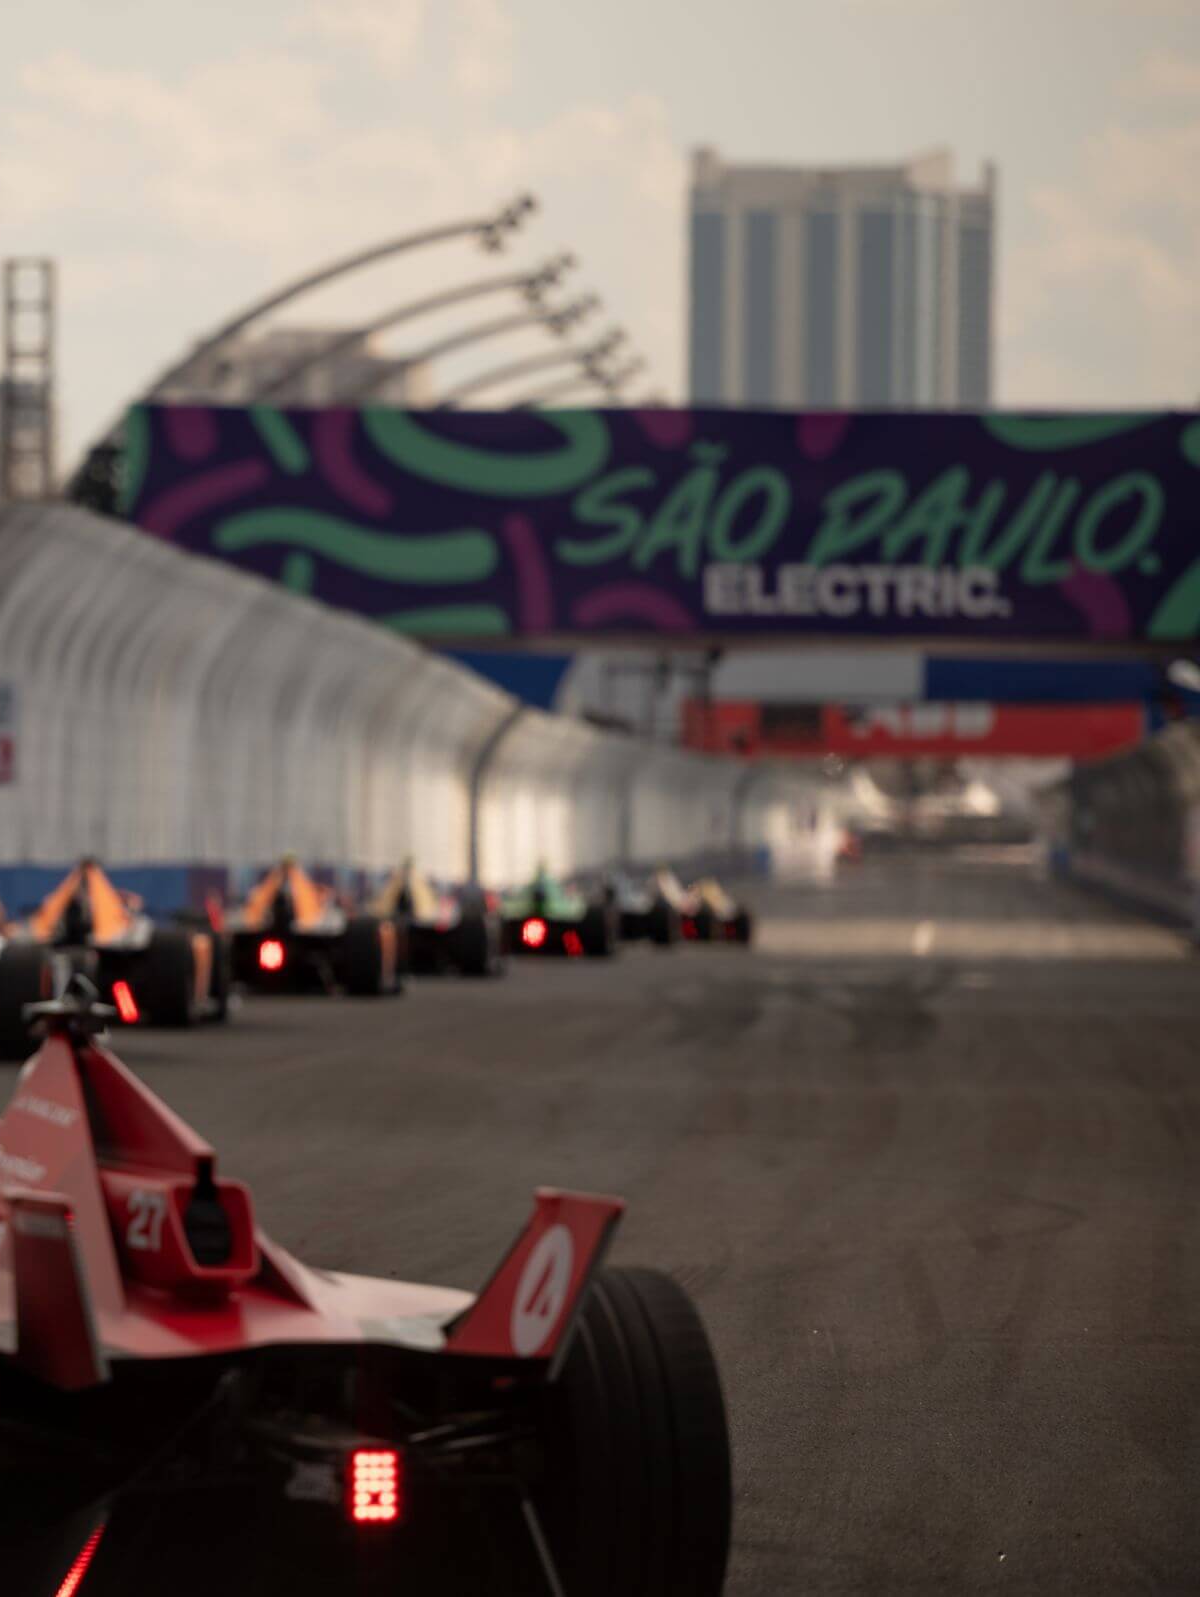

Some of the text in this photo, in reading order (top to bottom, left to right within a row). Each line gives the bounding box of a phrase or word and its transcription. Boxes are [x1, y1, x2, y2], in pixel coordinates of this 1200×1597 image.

[556, 440, 792, 578] SÃO
[703, 564, 1012, 618] ELECTRIC.
[126, 1188, 167, 1252] 27
